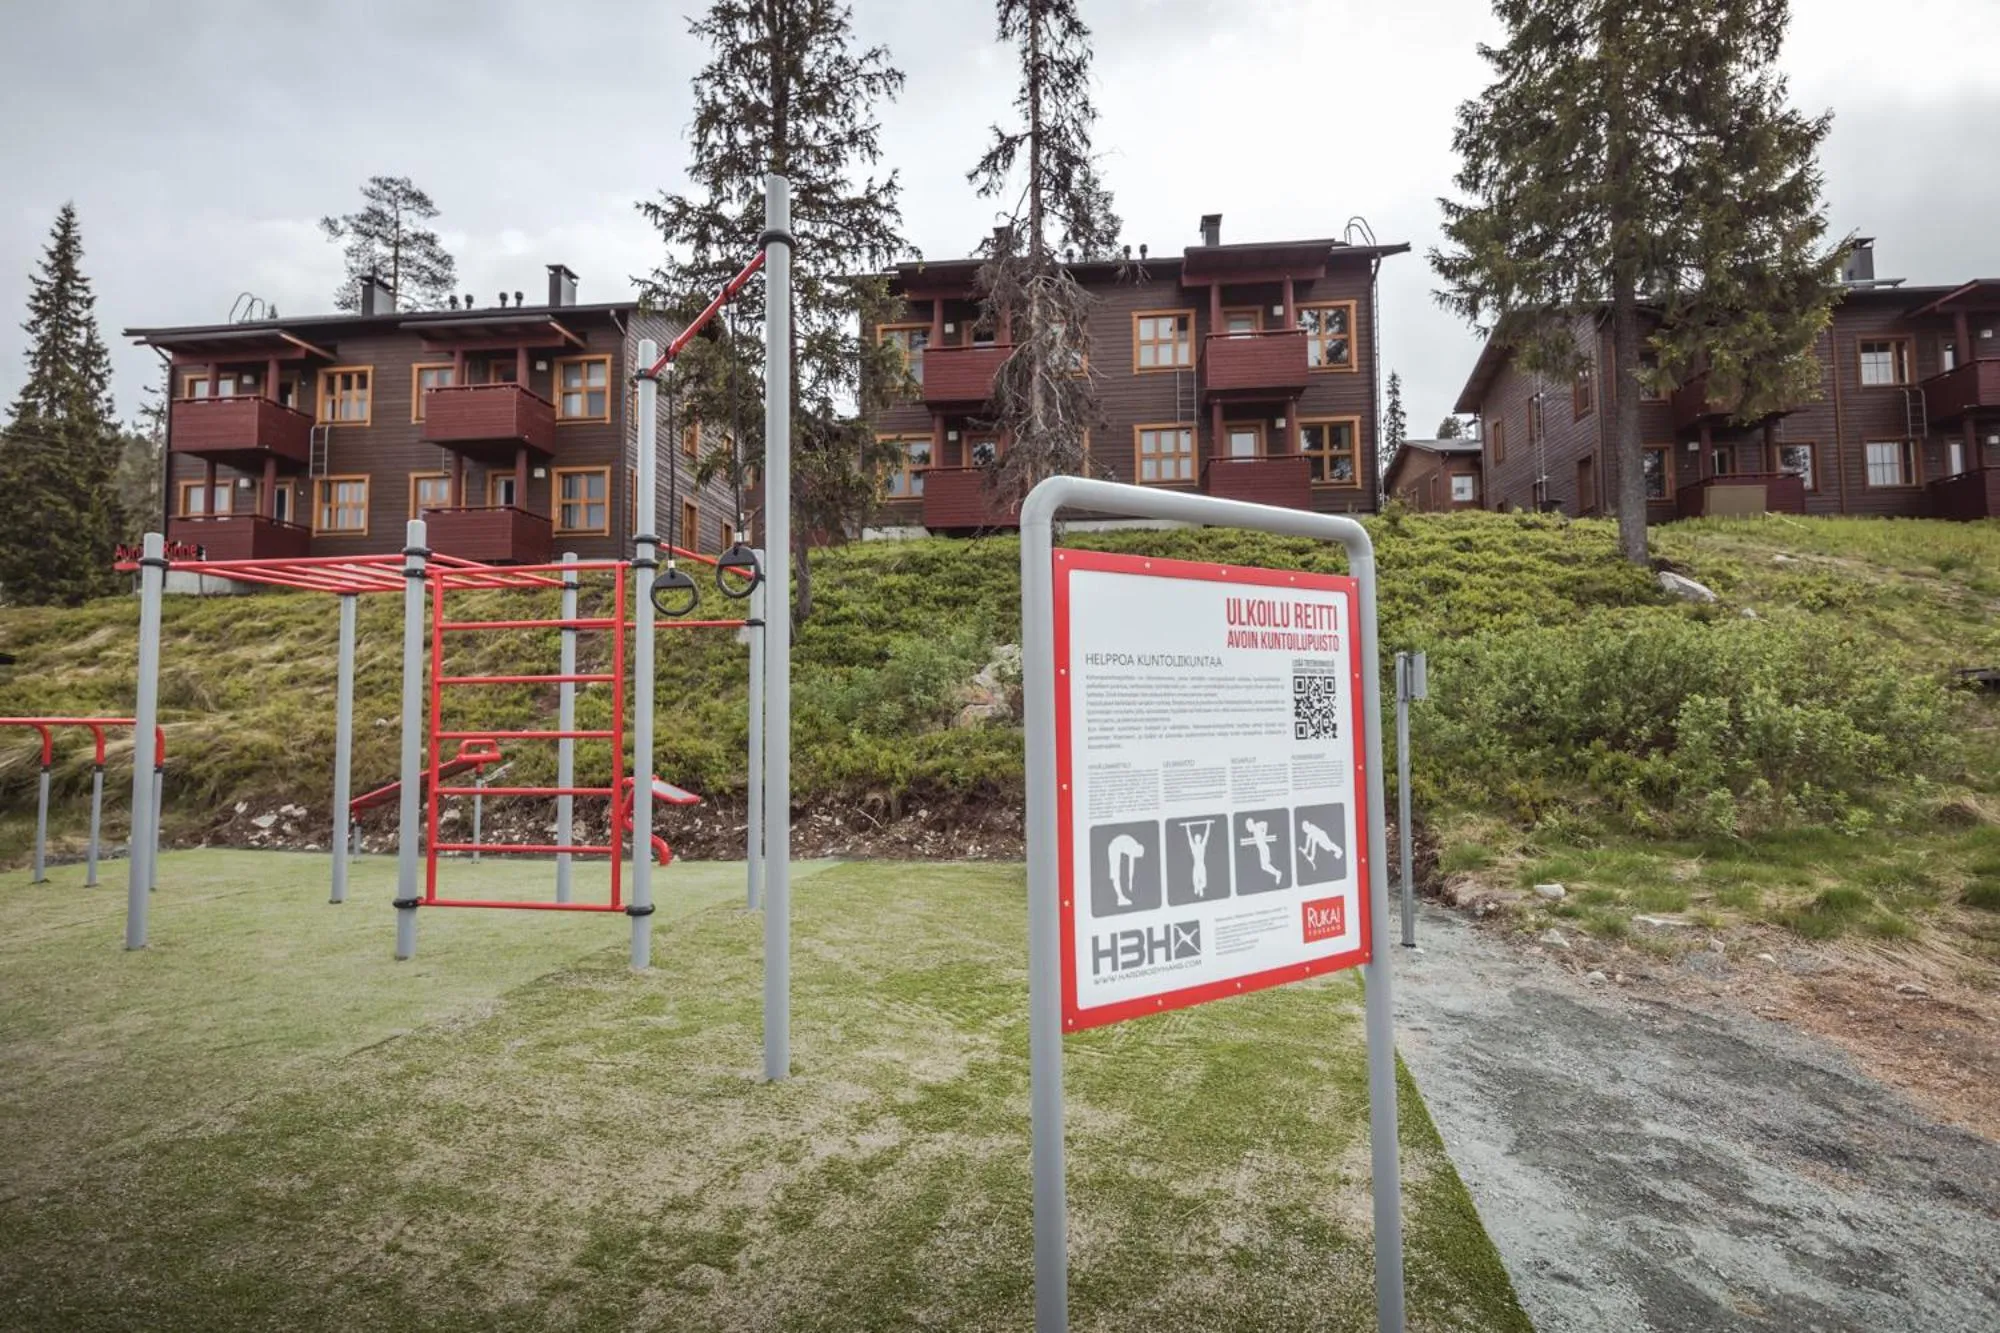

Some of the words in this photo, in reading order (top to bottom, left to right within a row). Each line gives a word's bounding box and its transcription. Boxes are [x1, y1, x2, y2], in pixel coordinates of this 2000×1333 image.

[1226, 597, 1290, 628] ULKOILU
[1294, 602, 1338, 631] REITTI
[1227, 630, 1258, 649] AVOIN
[1260, 632, 1340, 652] KUNTOILUPUISTO
[1086, 653, 1135, 666] HELPPOA
